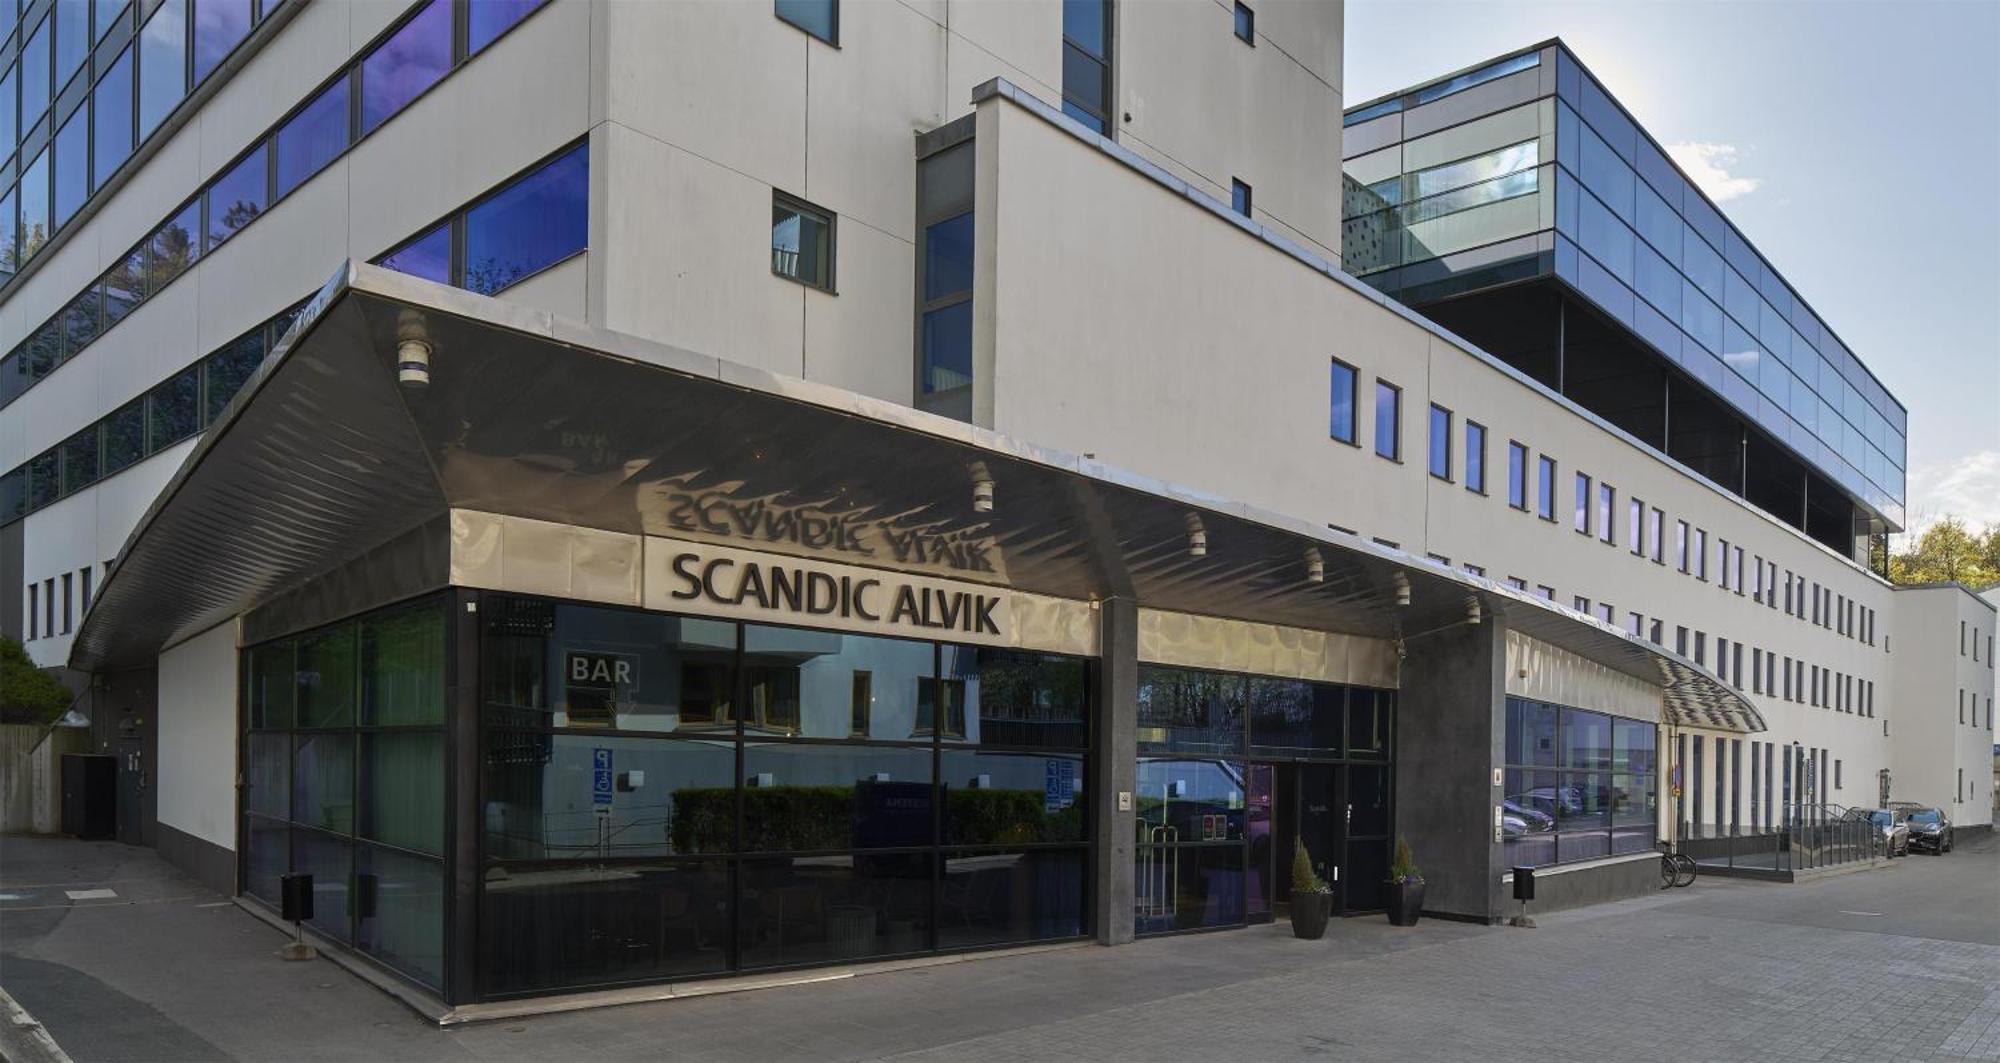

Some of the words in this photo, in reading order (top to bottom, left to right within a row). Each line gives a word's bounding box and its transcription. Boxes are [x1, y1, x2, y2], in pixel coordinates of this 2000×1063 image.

[671, 553, 881, 621] SCANDIC
[890, 584, 1001, 635] ALVIK
[571, 656, 632, 684] BAR
